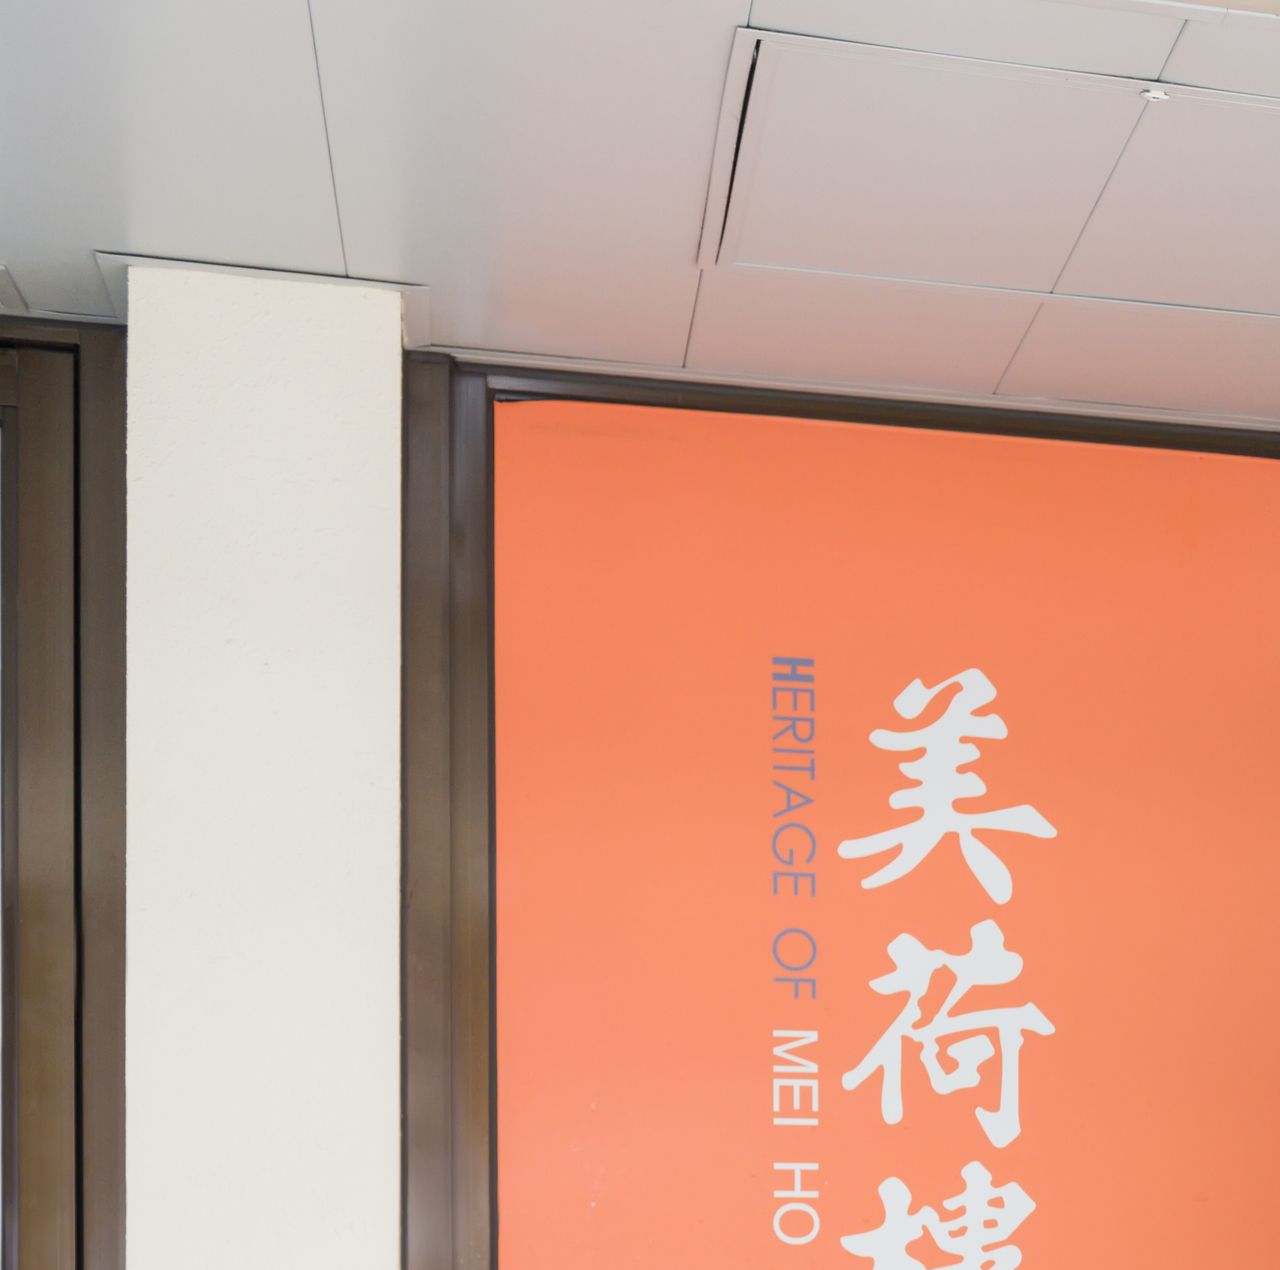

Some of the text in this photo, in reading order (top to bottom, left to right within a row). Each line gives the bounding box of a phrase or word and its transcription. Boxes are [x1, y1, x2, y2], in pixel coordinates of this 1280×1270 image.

[771, 656, 817, 896] HERITAGE
[772, 928, 817, 999] OF
[772, 1030, 819, 1126] MEI
[773, 1162, 820, 1245] HO
